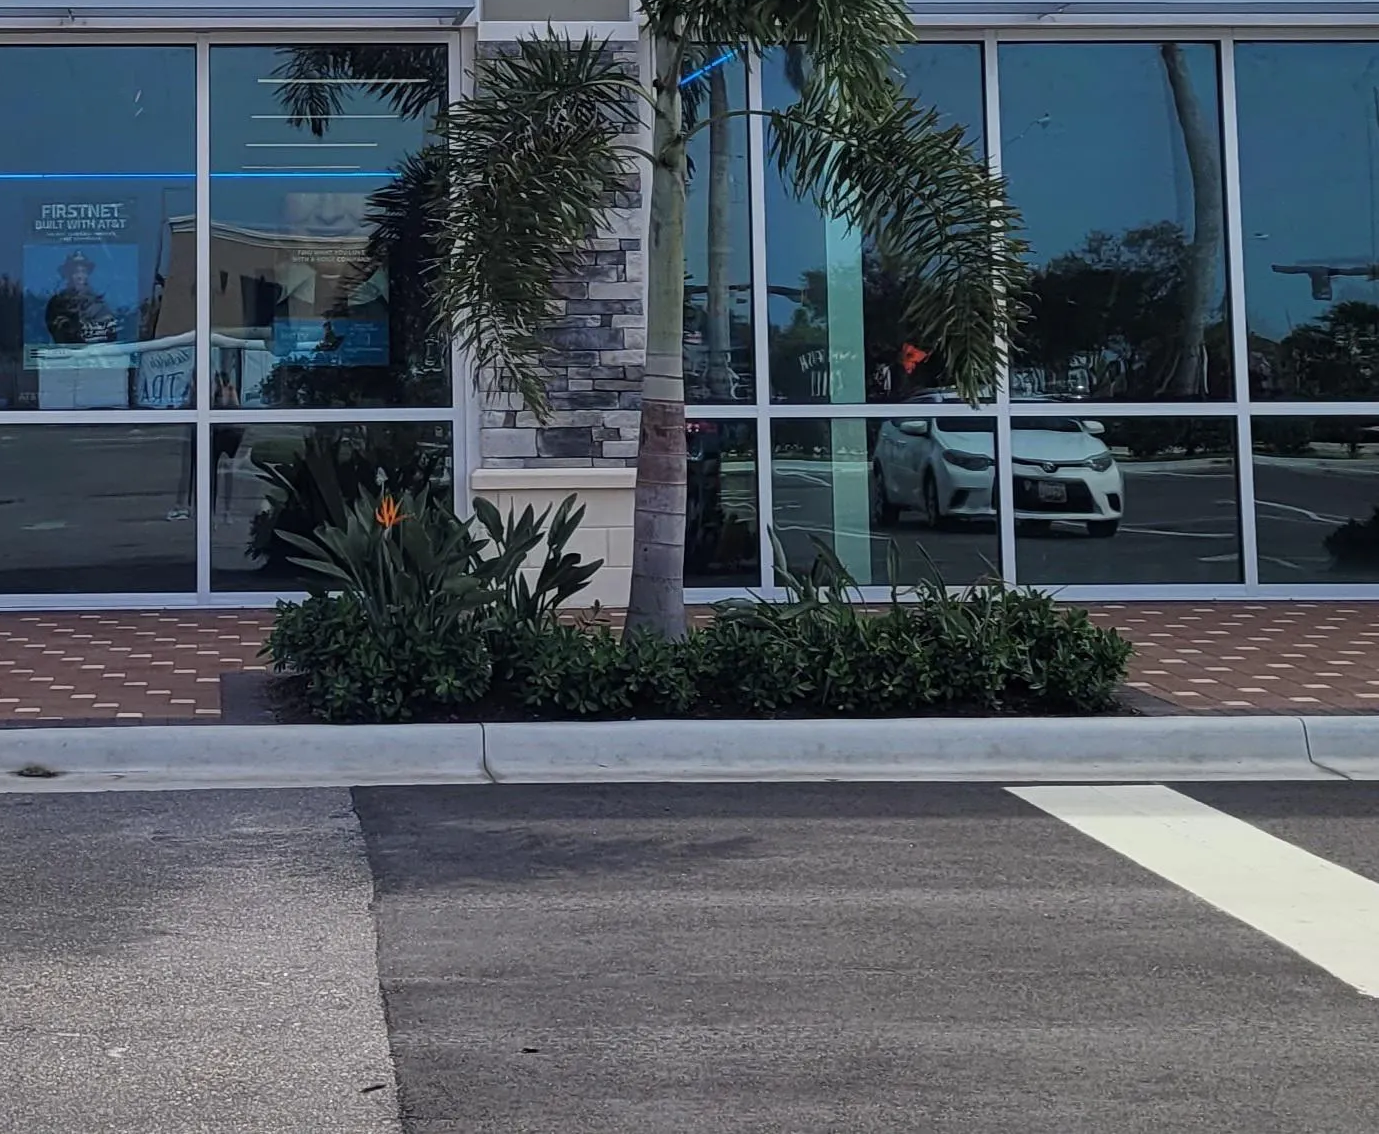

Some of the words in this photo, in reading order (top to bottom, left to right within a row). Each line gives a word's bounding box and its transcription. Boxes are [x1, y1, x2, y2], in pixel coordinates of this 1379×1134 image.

[41, 203, 120, 218] FIRSTNET
[35, 219, 64, 229] BUILT
[67, 219, 96, 229] WITH
[98, 218, 127, 229] AT&T
